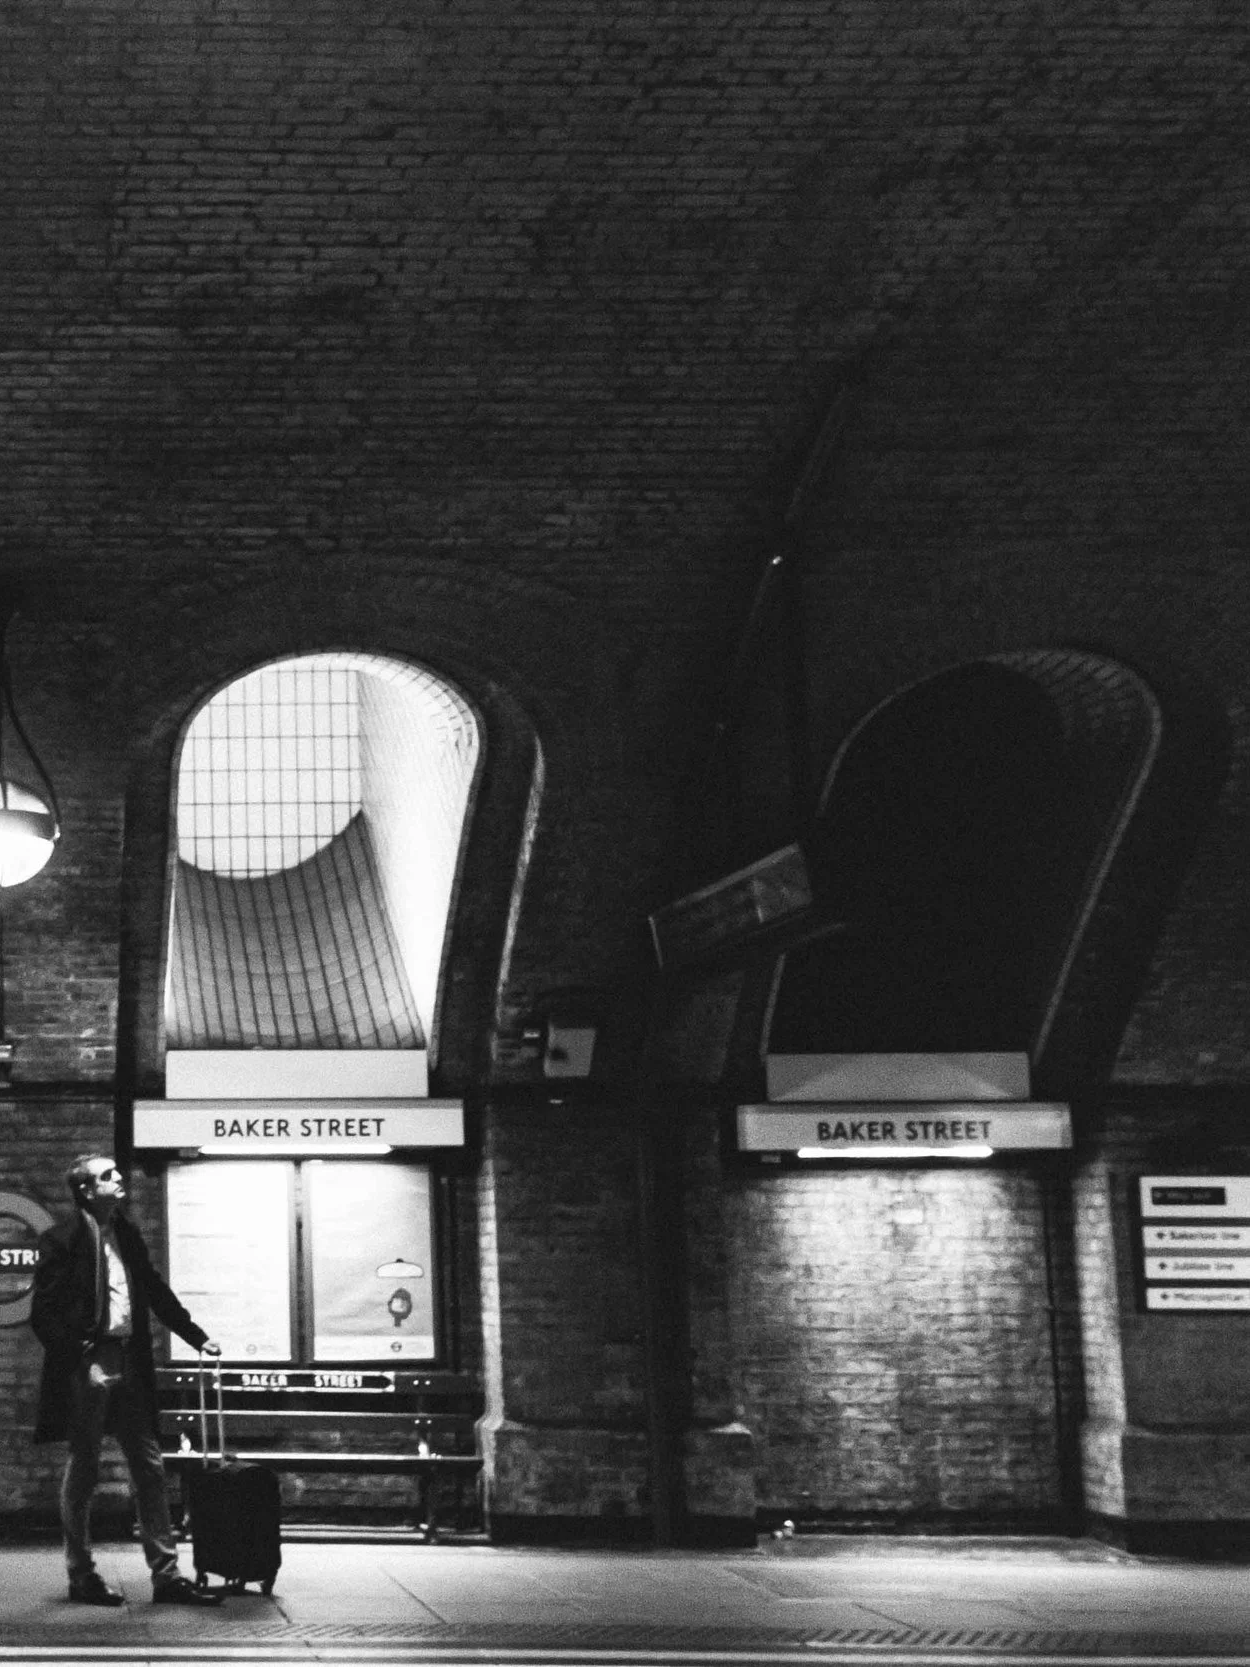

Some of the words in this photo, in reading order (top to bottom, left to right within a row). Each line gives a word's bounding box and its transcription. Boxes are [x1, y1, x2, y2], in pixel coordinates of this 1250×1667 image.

[214, 1118, 290, 1138] BAKER
[300, 1117, 385, 1137] STREET
[816, 1121, 897, 1142] BAKER
[905, 1120, 993, 1141] STREET
[0, 1248, 40, 1265] STR
[241, 1373, 288, 1386] BAKER
[314, 1374, 363, 1388] STREET
